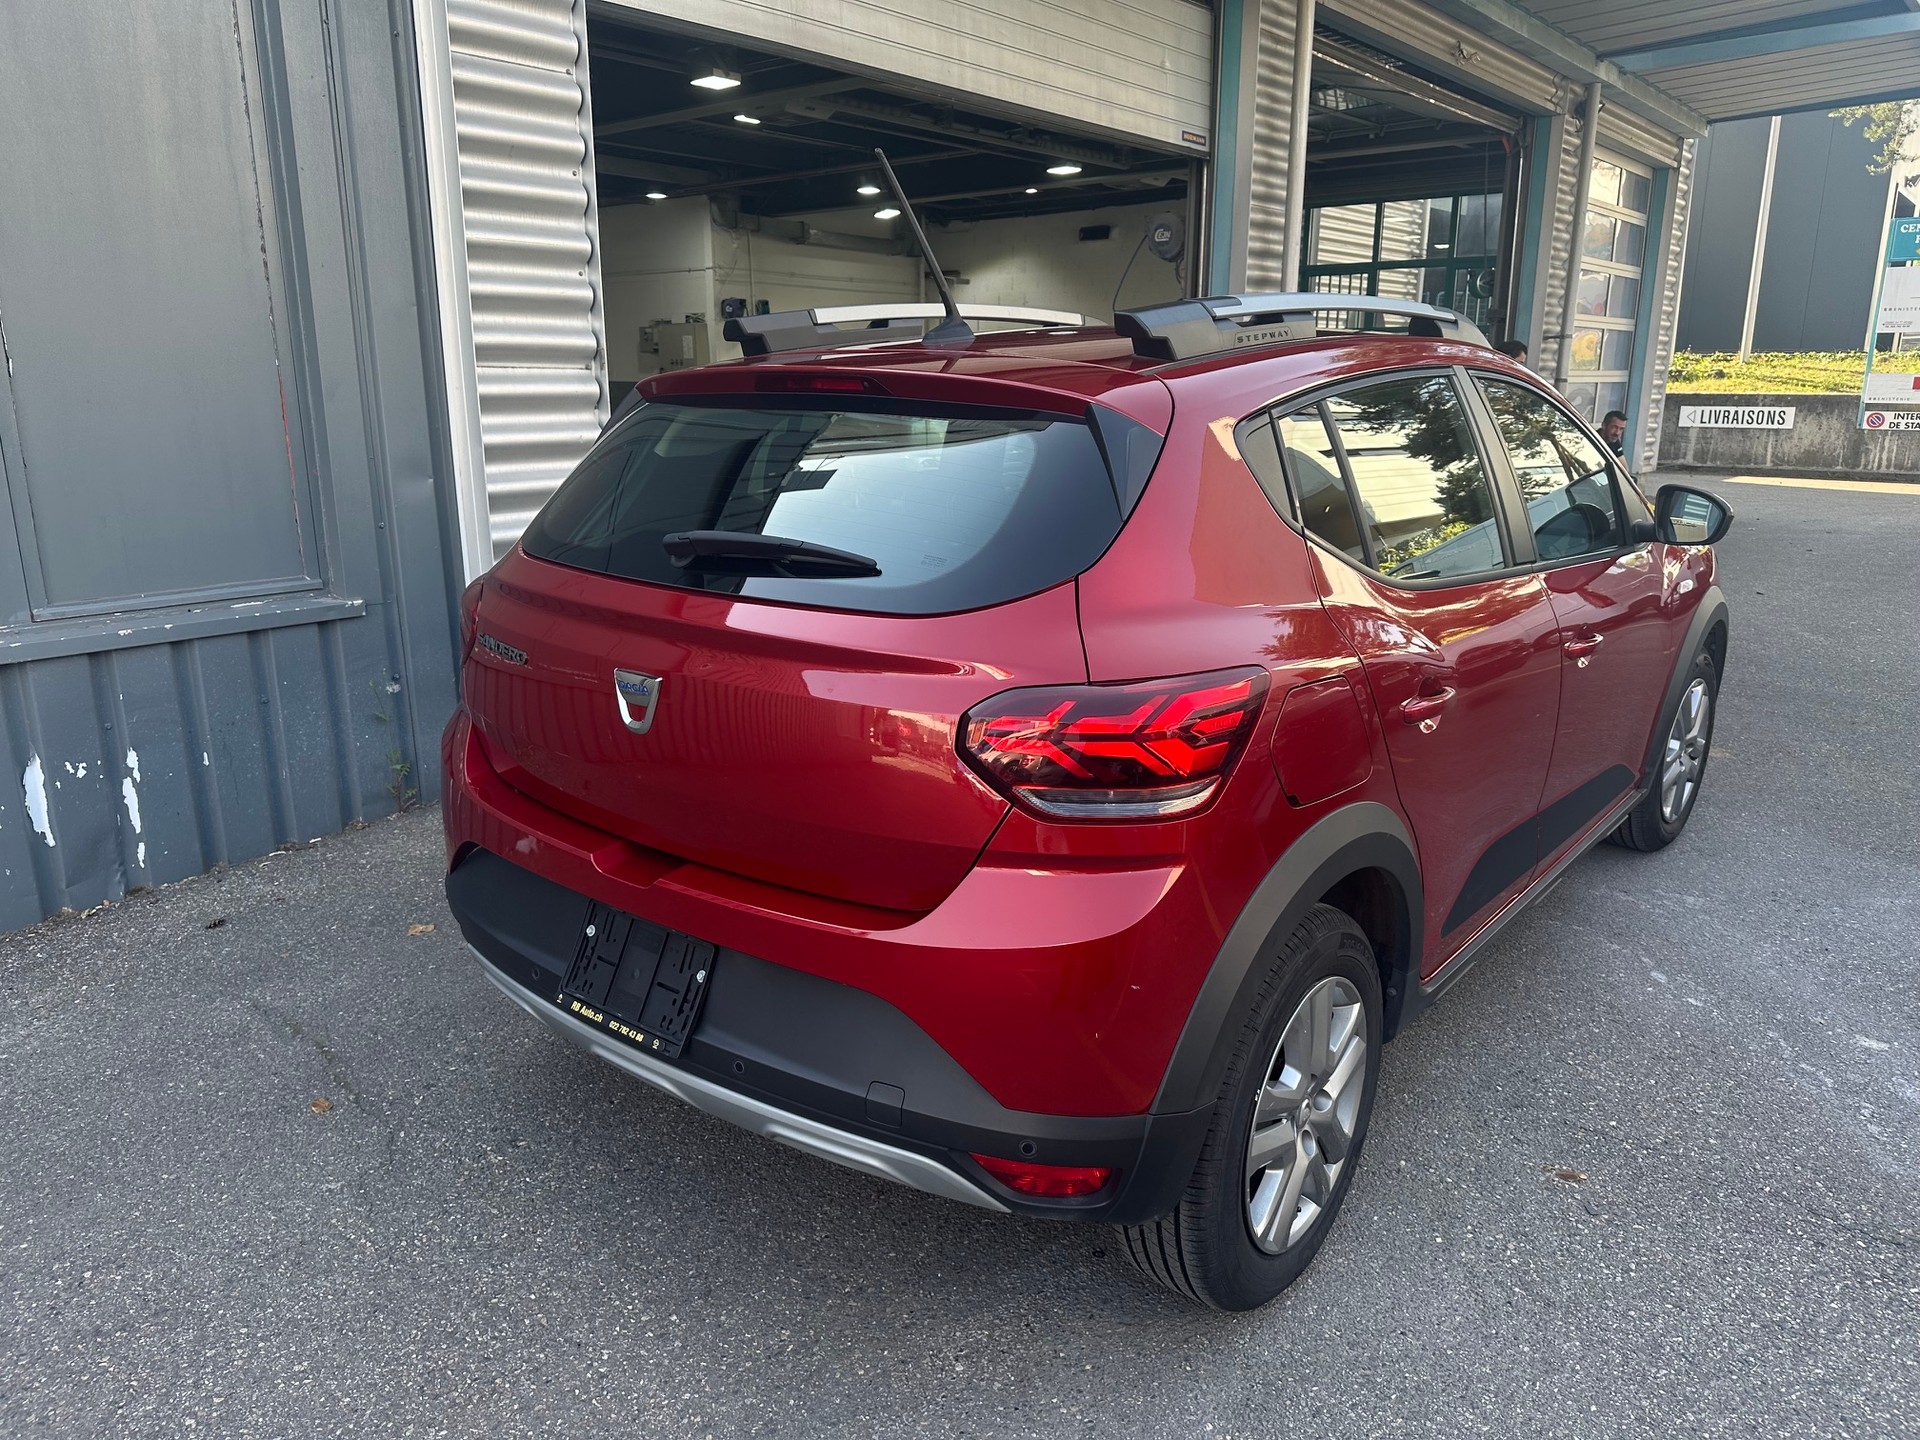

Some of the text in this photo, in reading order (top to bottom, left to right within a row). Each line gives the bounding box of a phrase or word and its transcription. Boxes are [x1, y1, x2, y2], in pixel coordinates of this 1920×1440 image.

[1236, 329, 1289, 344] STEPWAY
[1700, 409, 1786, 426] LIVRAISONS
[1888, 421, 1901, 429] DE
[479, 632, 528, 665] SANDERO
[618, 680, 648, 694] DACIA
[571, 1000, 581, 1011] RB
[580, 1005, 603, 1022] Auto.ch
[609, 1020, 619, 1030] 022
